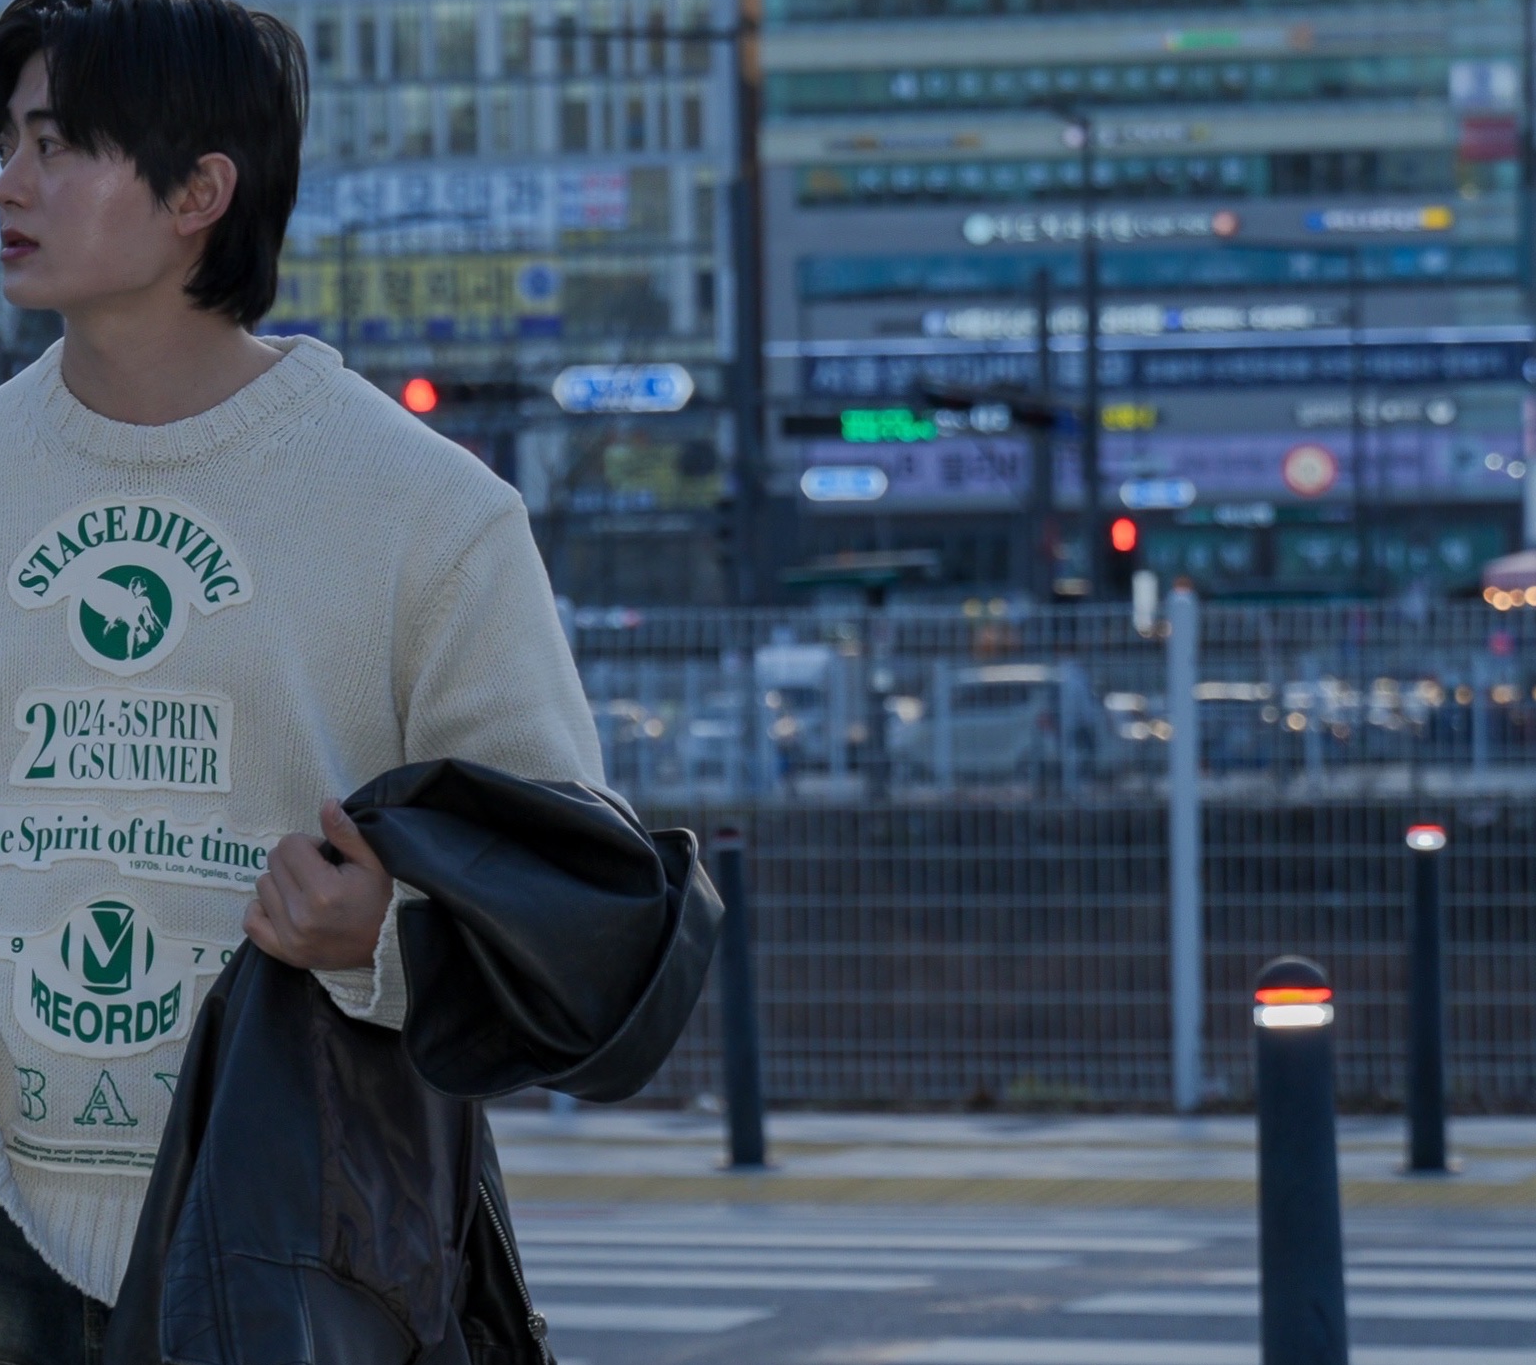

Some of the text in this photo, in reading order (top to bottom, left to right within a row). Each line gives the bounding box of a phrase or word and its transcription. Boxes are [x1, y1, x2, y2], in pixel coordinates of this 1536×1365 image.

[18, 505, 240, 604] STAGE DIVING
[69, 742, 218, 785] GSUMMER
[18, 815, 102, 862] Spirit
[108, 817, 143, 854] of
[144, 819, 193, 859] the
[129, 860, 162, 872] 1970s,
[165, 862, 185, 873] Los
[186, 865, 232, 881] Angeles,
[30, 967, 182, 1045] PREORDER
